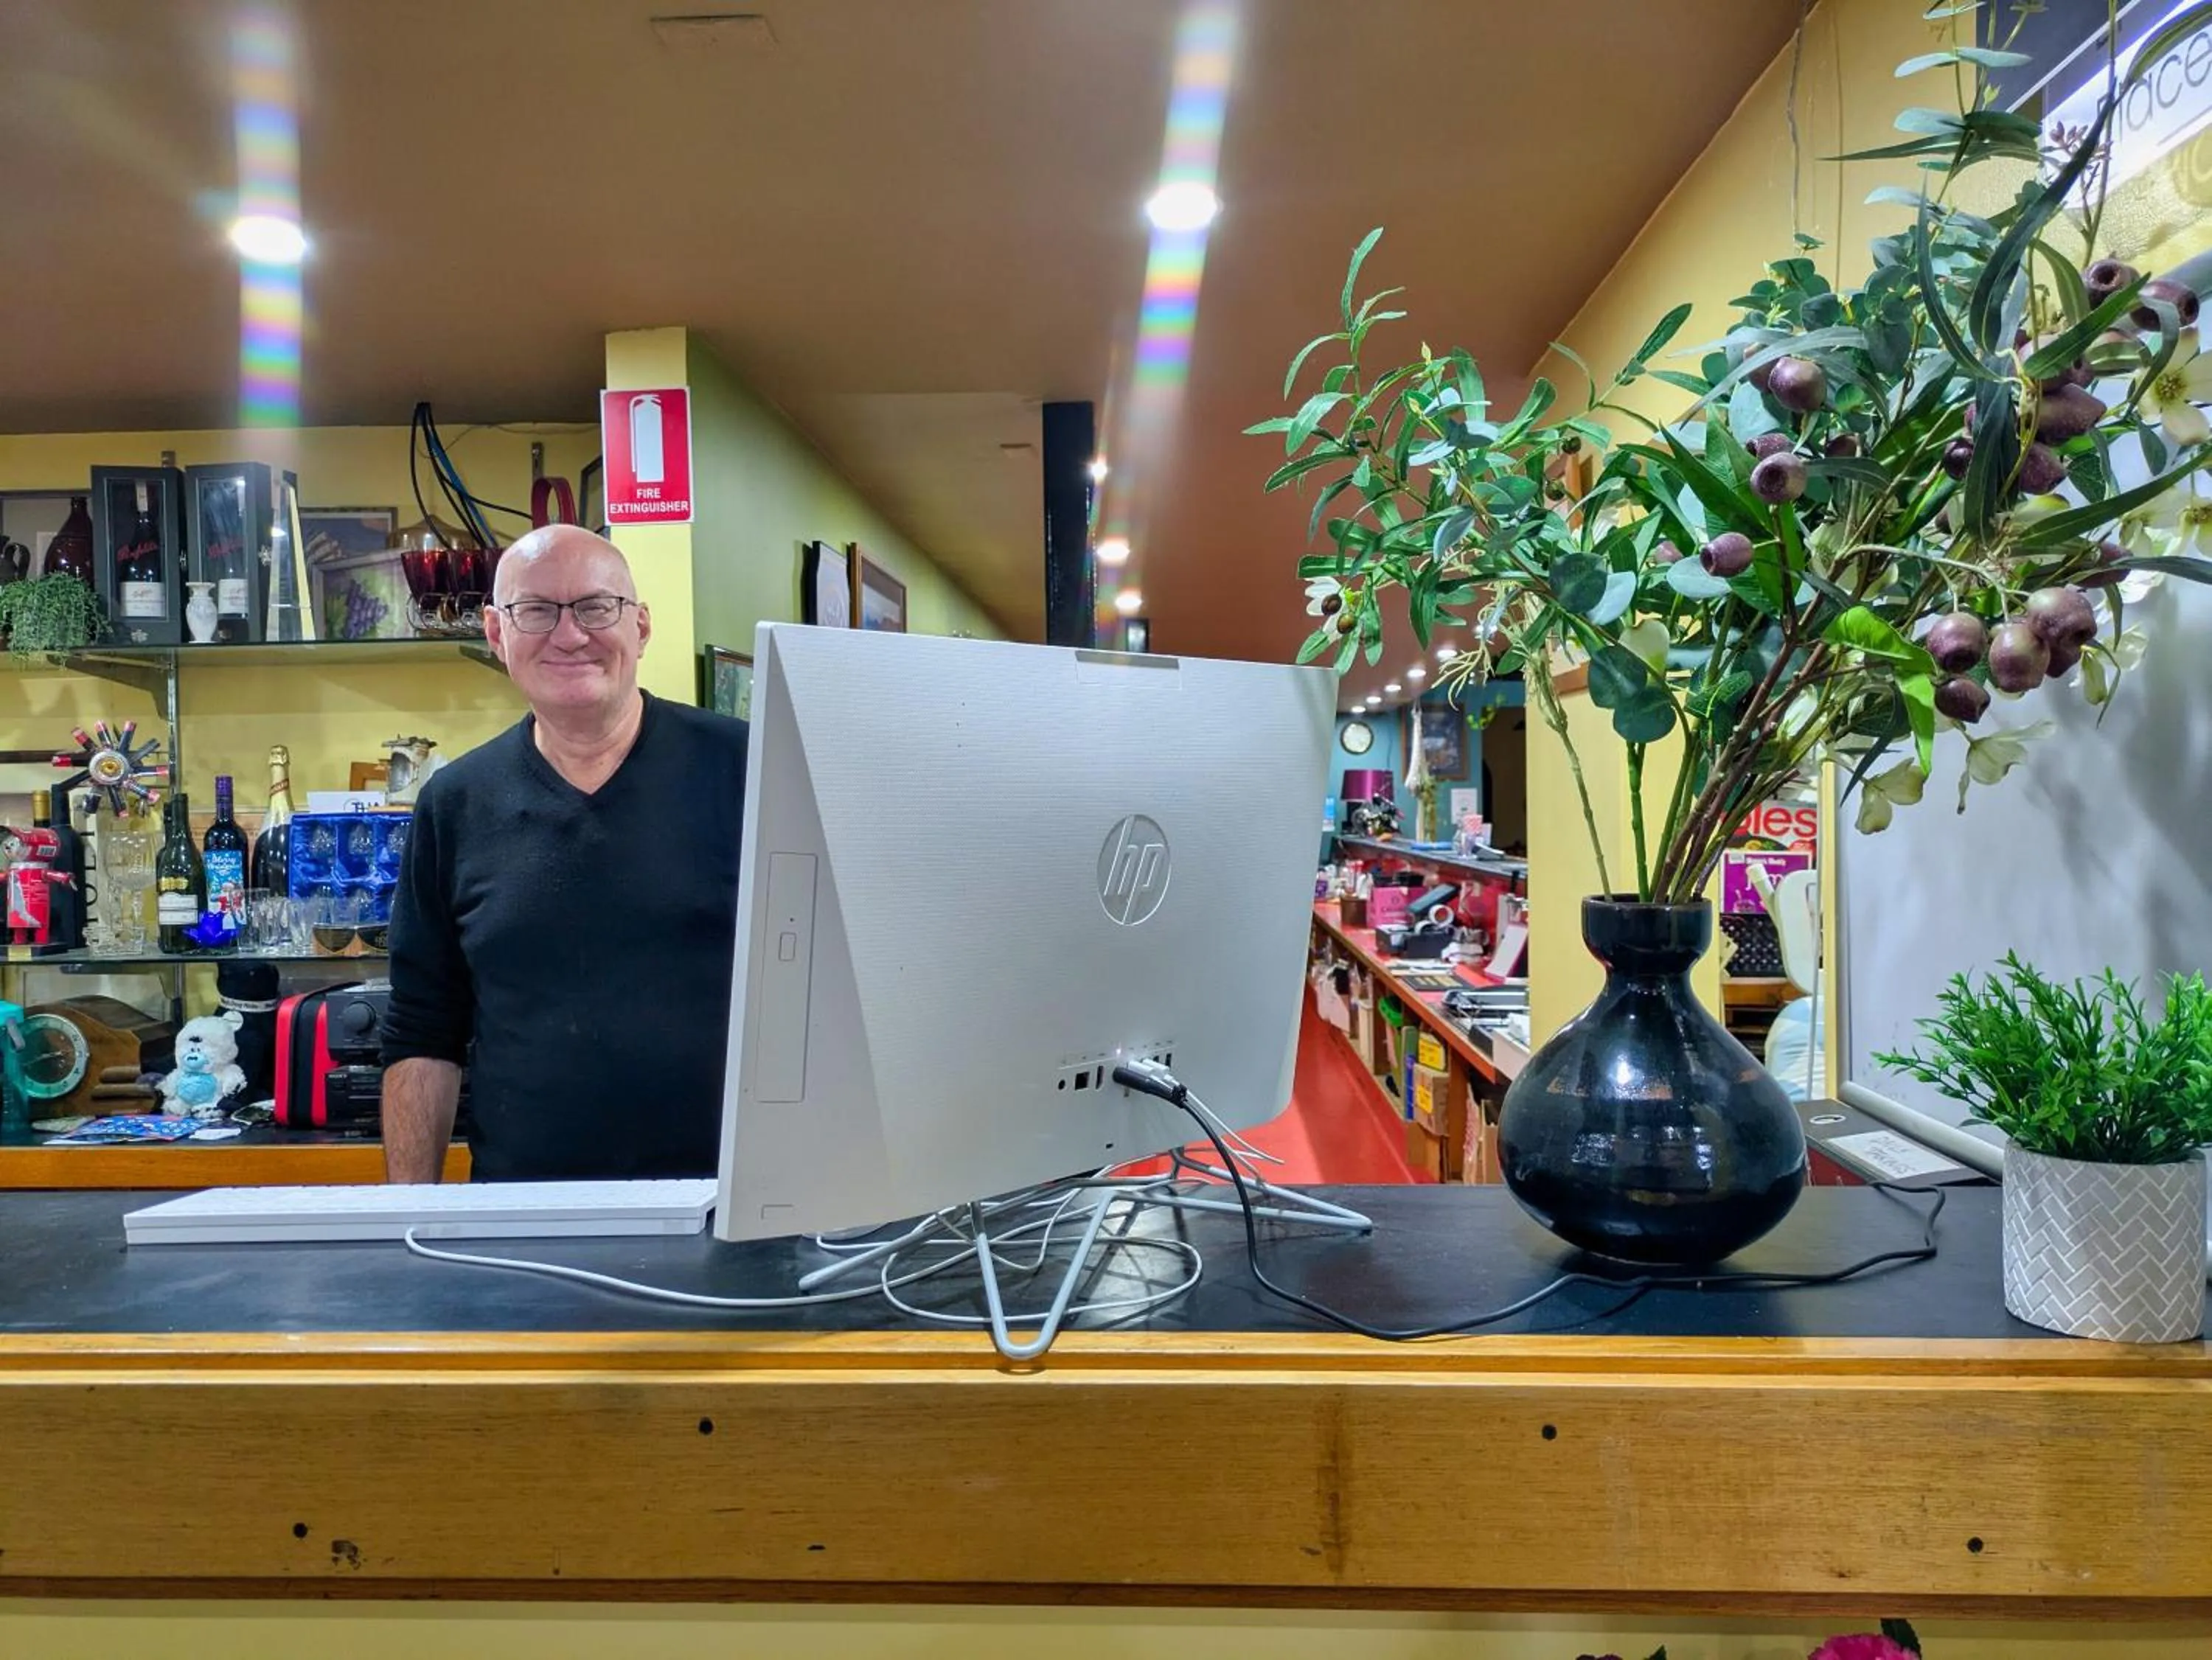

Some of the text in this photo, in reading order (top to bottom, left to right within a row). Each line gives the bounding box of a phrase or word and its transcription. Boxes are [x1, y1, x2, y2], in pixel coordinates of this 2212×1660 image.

[2097, 31, 2212, 146] lace
[610, 501, 689, 514] EXTINGUISHER
[636, 487, 661, 499] FIRE
[1104, 815, 1166, 926] hp
